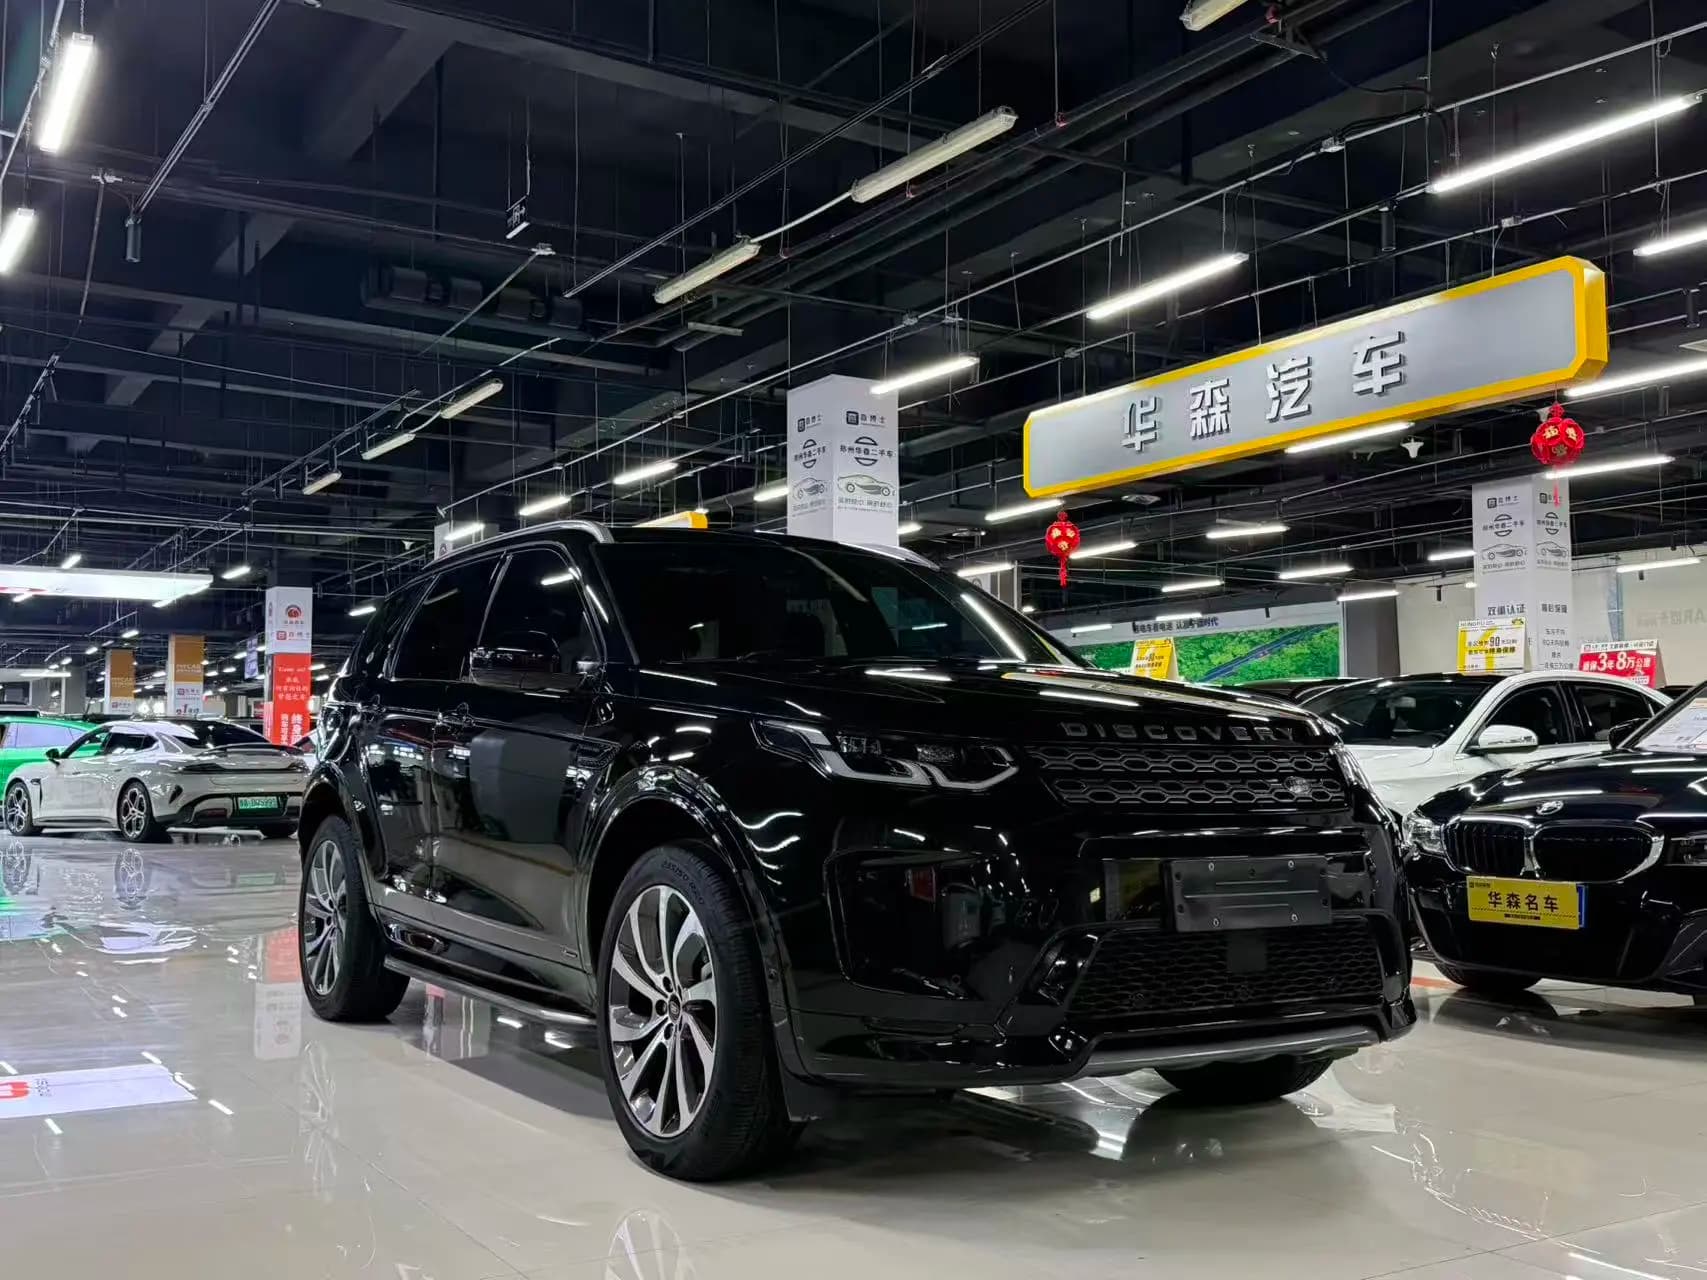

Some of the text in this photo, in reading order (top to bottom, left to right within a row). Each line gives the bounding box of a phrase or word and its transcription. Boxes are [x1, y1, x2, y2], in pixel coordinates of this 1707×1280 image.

[1122, 331, 1405, 452] 华森汽车
[1060, 721, 1294, 741] DISCOVERY
[1487, 890, 1560, 913] 华森名车
